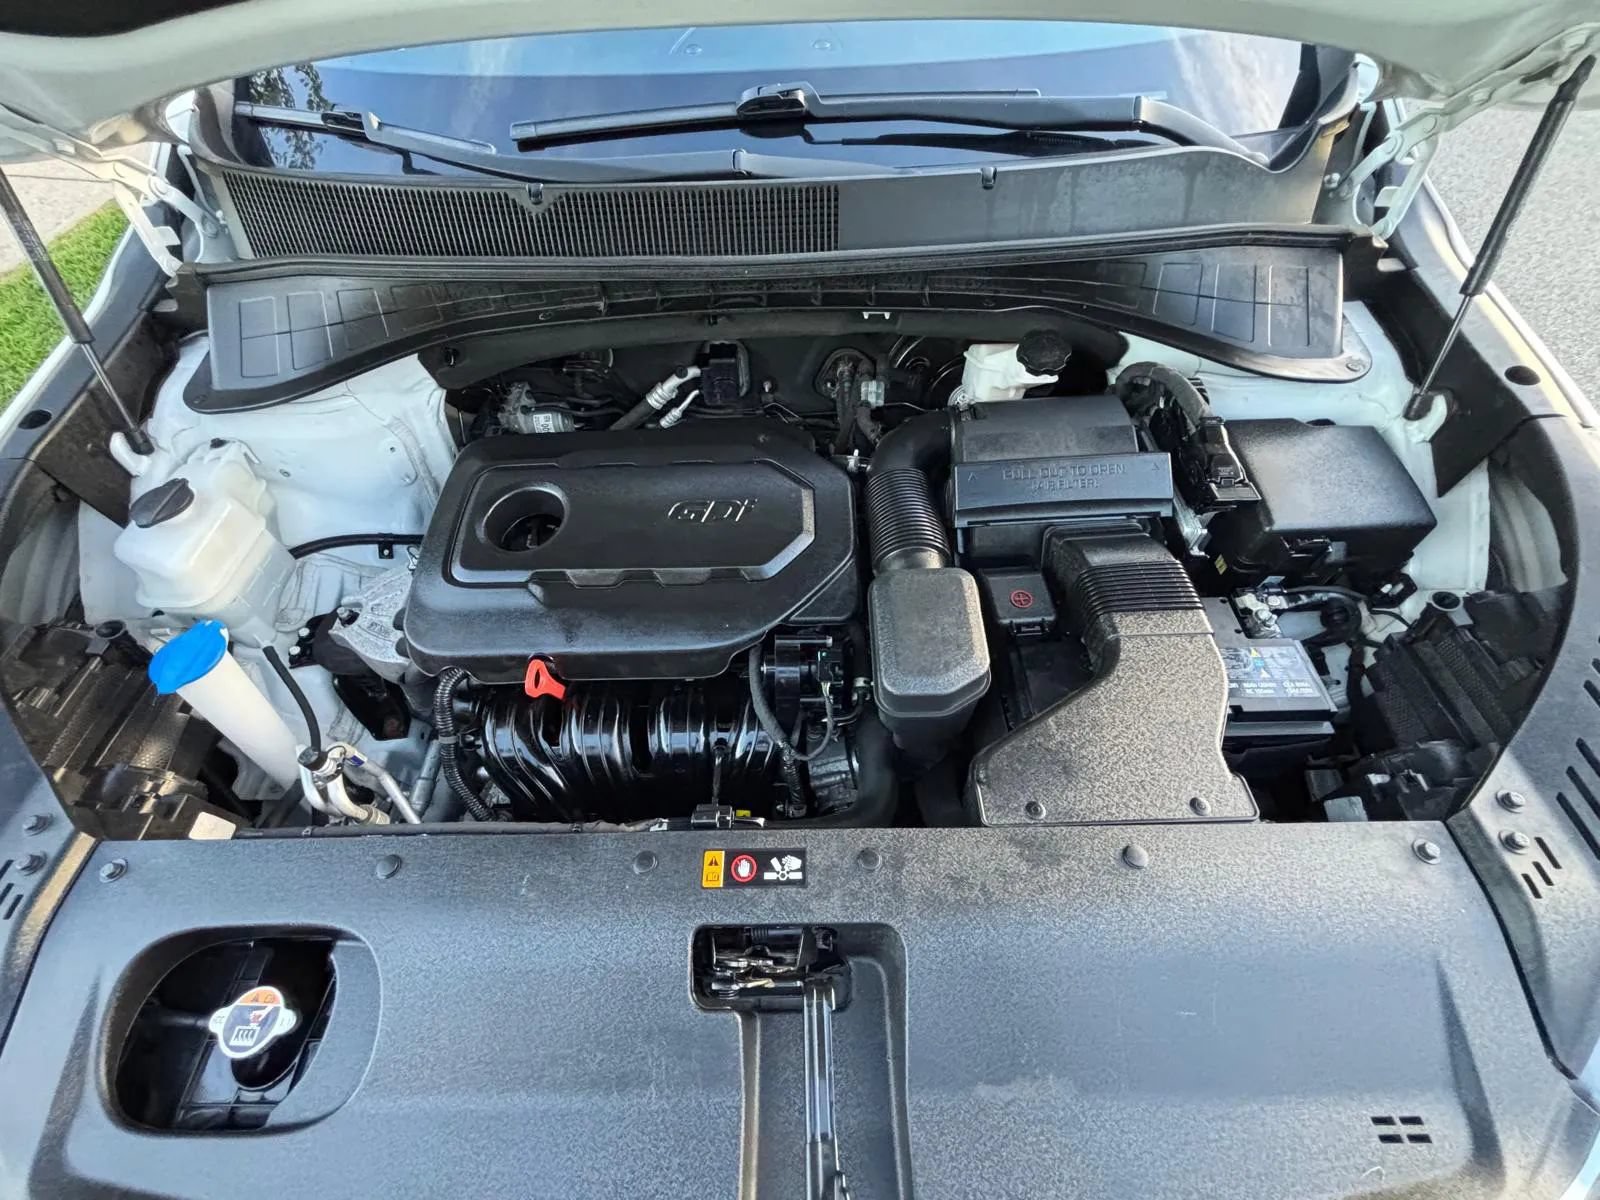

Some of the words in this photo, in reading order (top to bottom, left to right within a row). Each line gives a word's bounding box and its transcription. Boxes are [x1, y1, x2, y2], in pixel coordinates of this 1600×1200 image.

[1002, 468, 1036, 480] PULL
[1039, 466, 1066, 478] OUT
[1069, 465, 1087, 477] TO
[1089, 463, 1127, 475] OPEN
